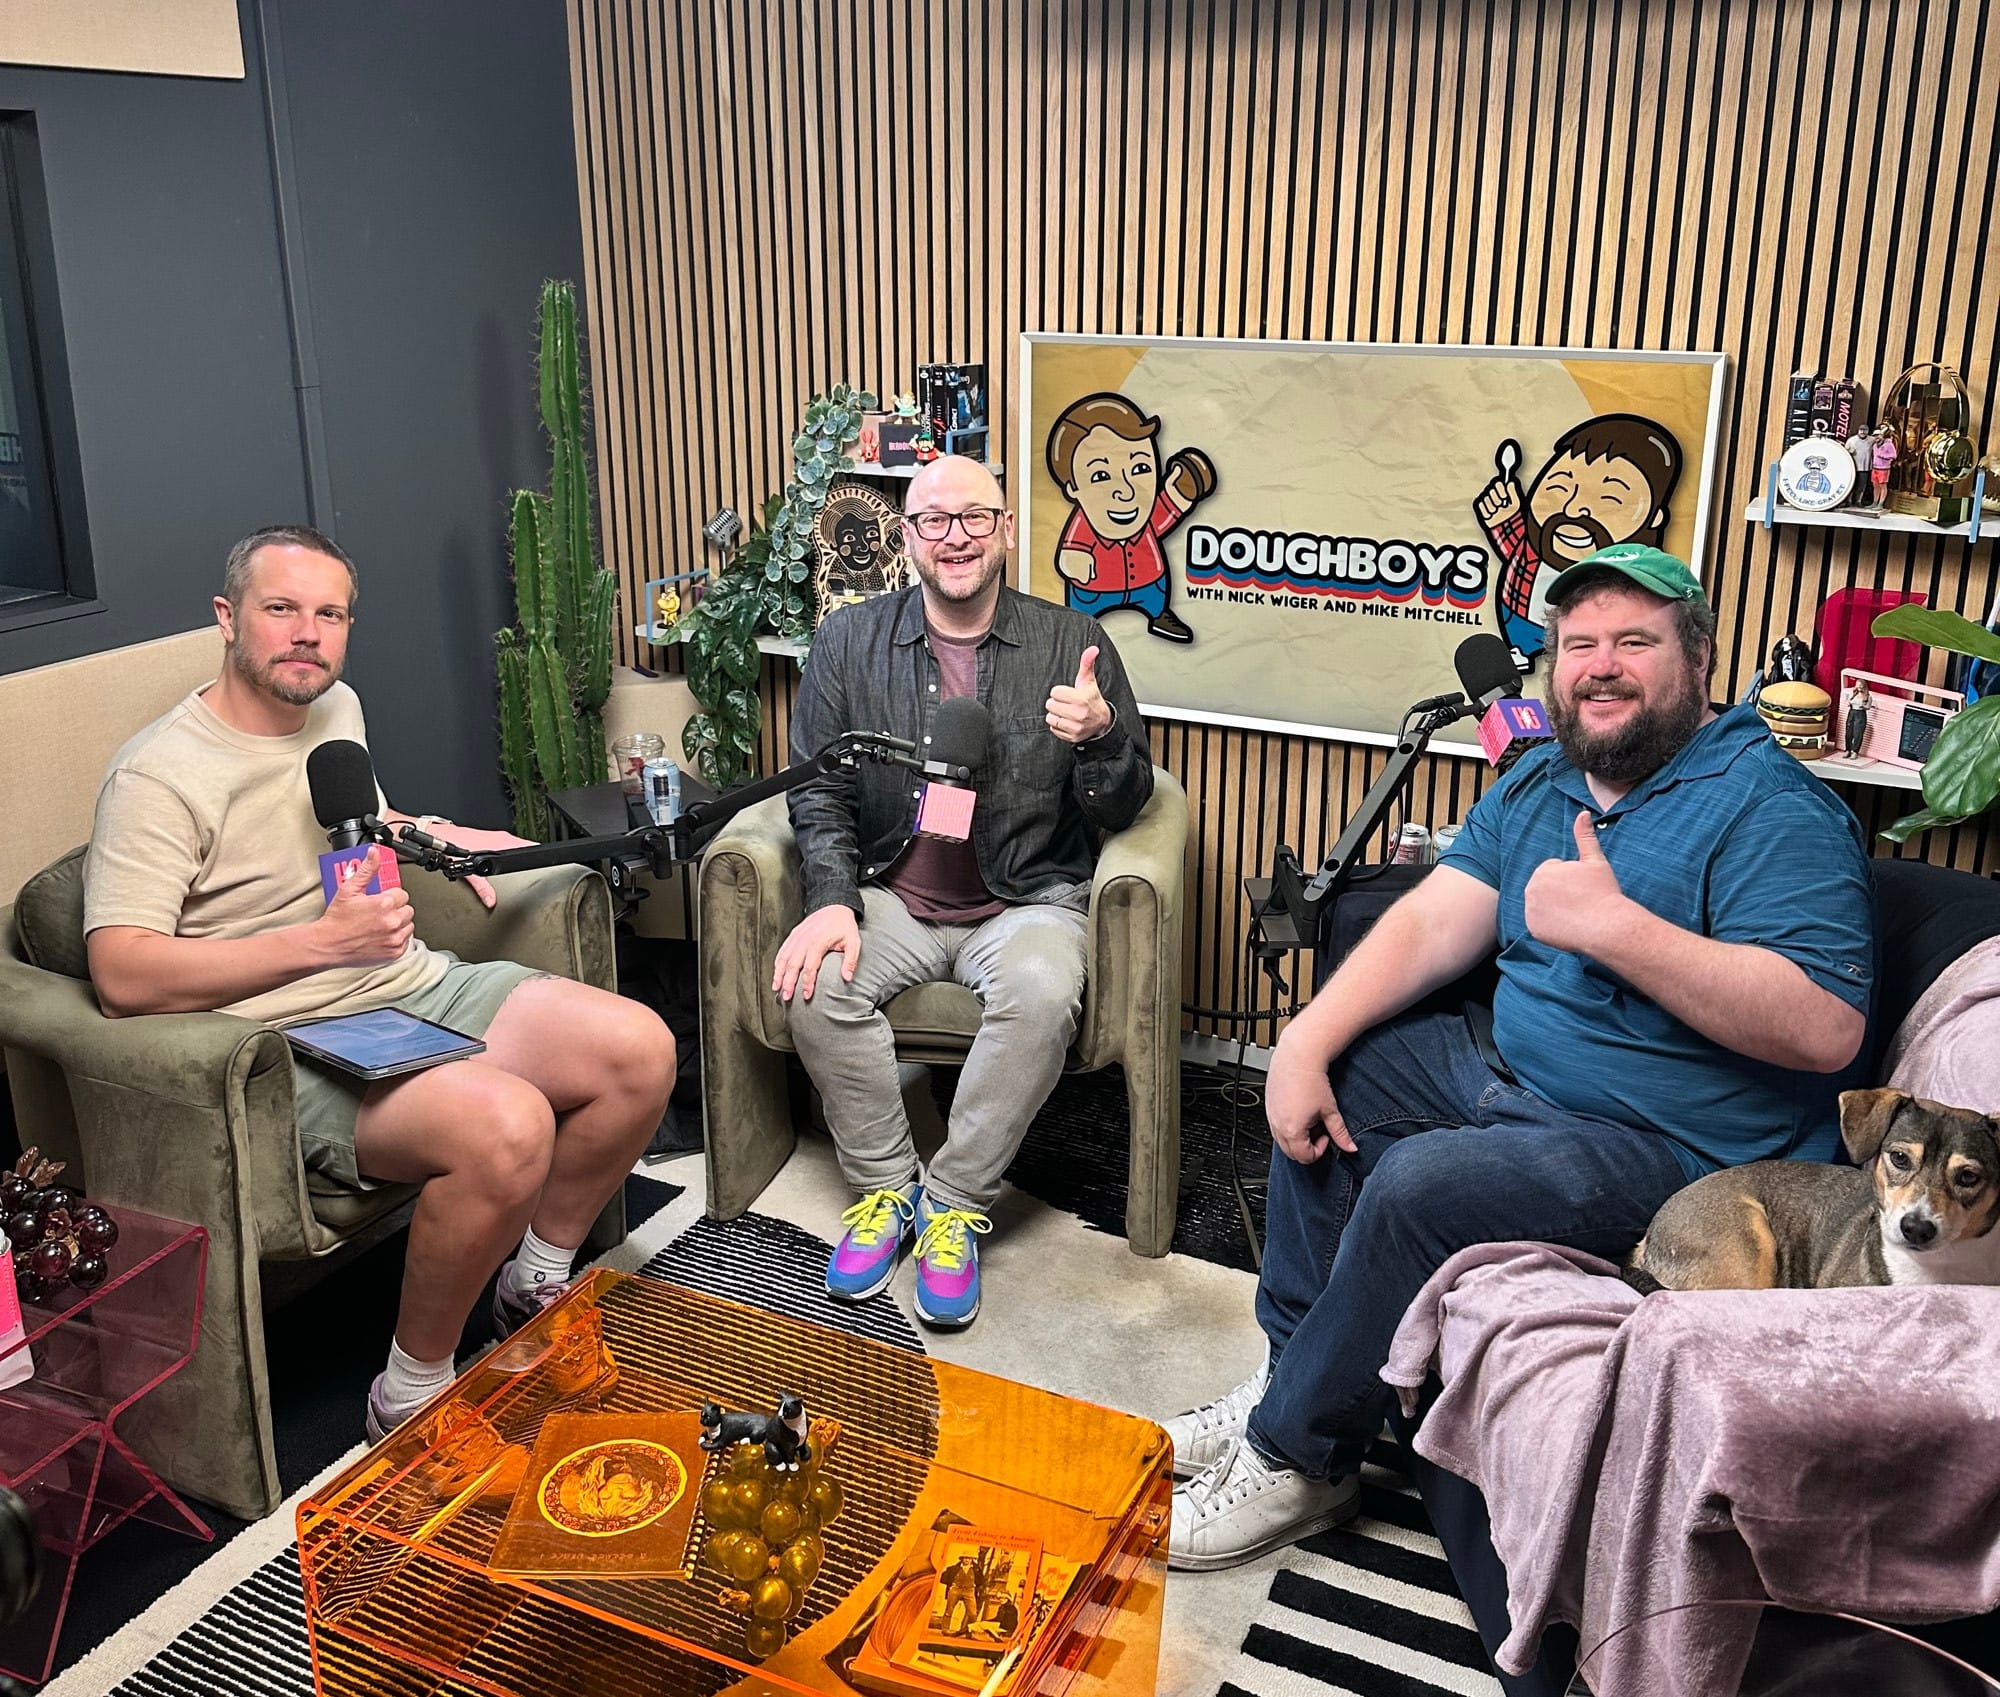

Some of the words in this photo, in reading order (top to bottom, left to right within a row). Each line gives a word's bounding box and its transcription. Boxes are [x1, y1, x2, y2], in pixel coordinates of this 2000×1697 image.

[1835, 401, 1851, 438] MOTEL
[1784, 483, 1798, 500] FEEL
[1188, 526, 1487, 592] DOUGHBOYS
[1186, 587, 1223, 601] WITH
[1228, 590, 1265, 605] NICK
[1270, 594, 1318, 610] WIGER
[1323, 599, 1357, 613] AND
[1362, 603, 1399, 618] MIKE
[1404, 607, 1483, 626] MITCHELL
